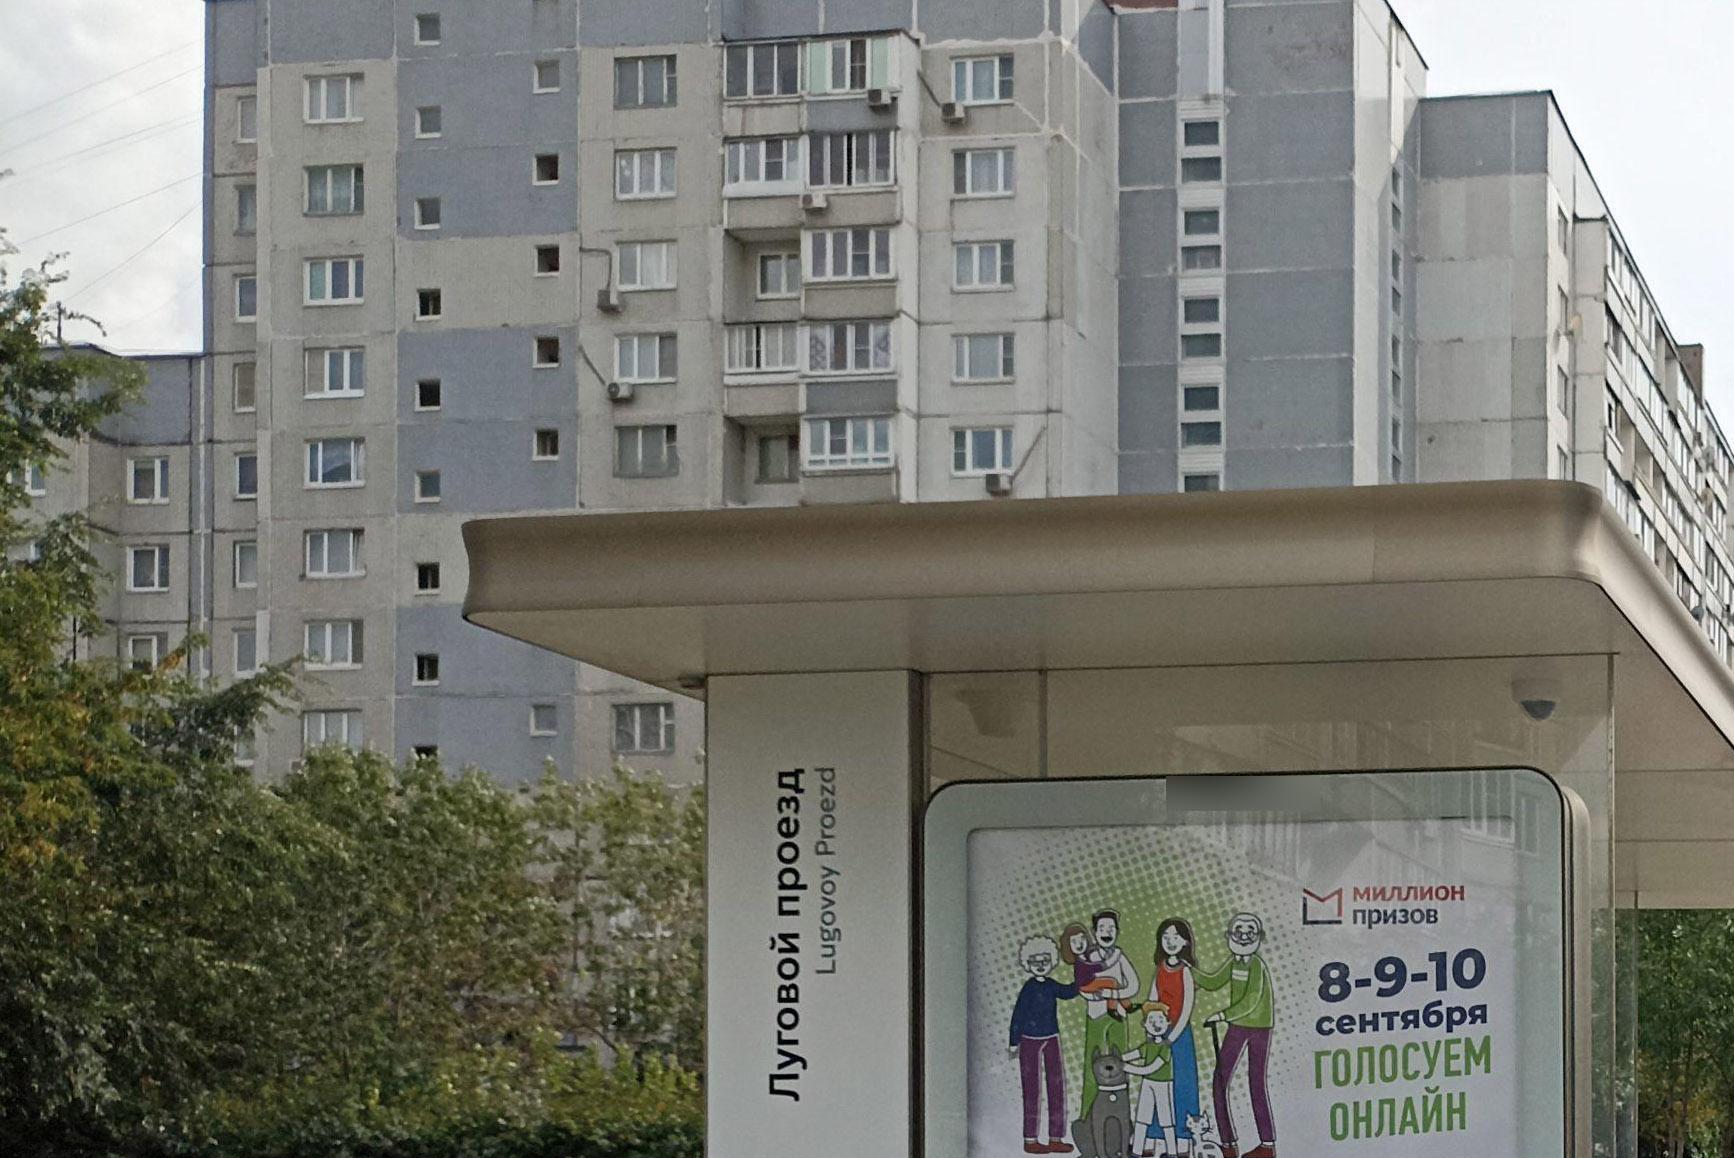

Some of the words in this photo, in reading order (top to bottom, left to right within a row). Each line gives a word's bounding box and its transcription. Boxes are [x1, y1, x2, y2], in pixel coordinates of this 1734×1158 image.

[813, 767, 837, 856] Proezd
[776, 768, 809, 917] проезд
[815, 865, 842, 976] Lugovoy
[1352, 908, 1439, 929] призов
[1318, 948, 1486, 1003] 8-9-10
[768, 932, 808, 1102] Луговой
[1315, 1000, 1488, 1036] сентября
[1314, 1035, 1492, 1089] ГОЛОСУЕМ
[1329, 1085, 1466, 1141] ОНЛАЙН
